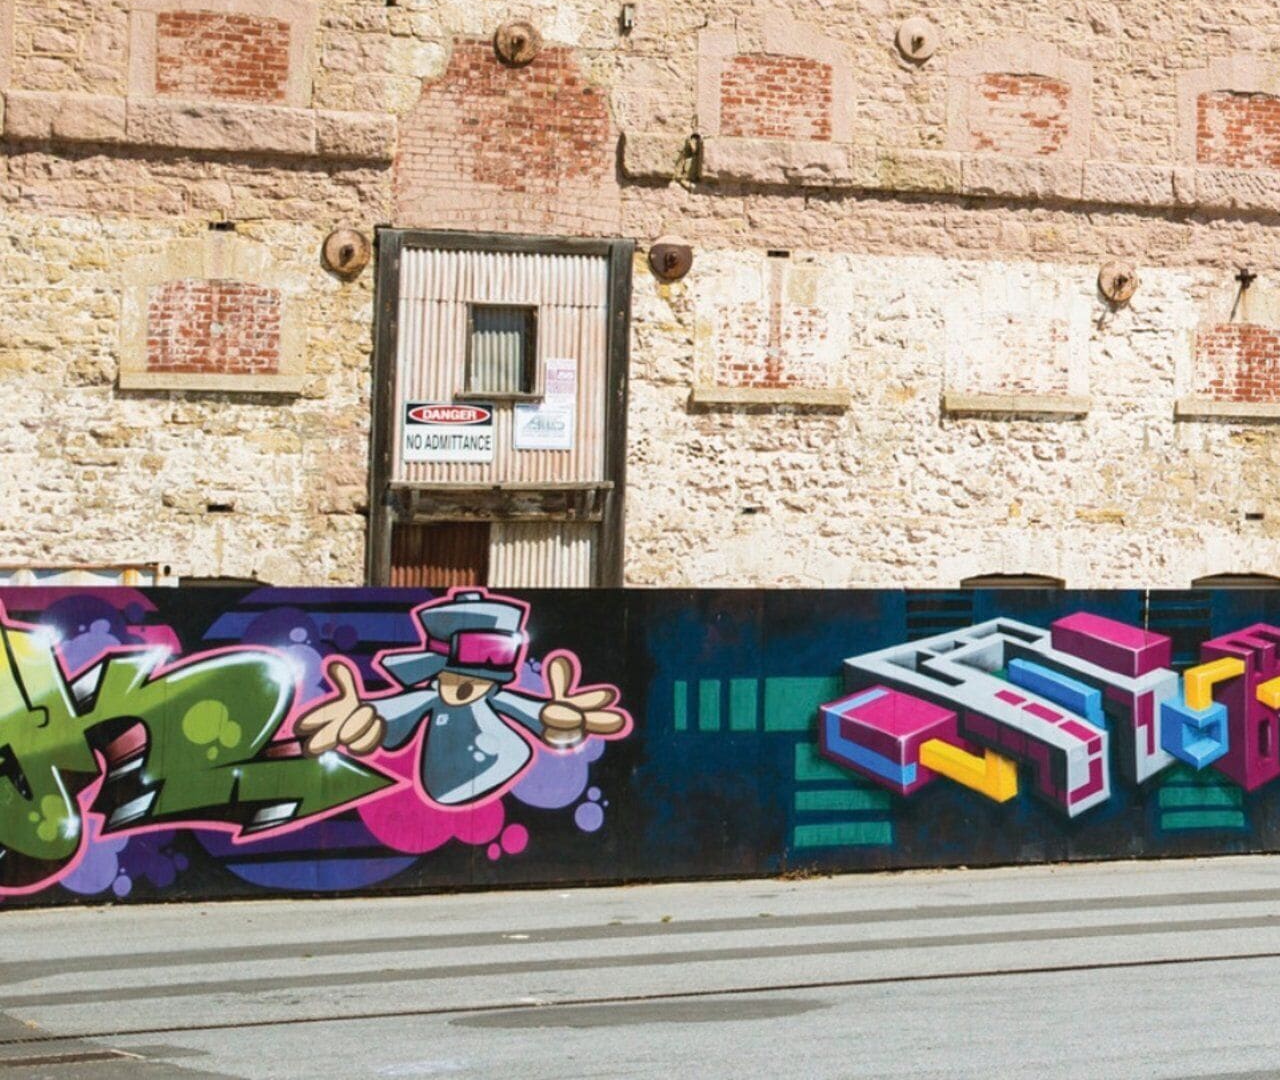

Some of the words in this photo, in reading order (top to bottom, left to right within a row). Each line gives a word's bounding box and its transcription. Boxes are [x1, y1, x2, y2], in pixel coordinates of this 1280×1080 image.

[422, 407, 478, 421] DANGER
[406, 434, 422, 450] NO
[425, 434, 492, 451] ADMITTANCE
